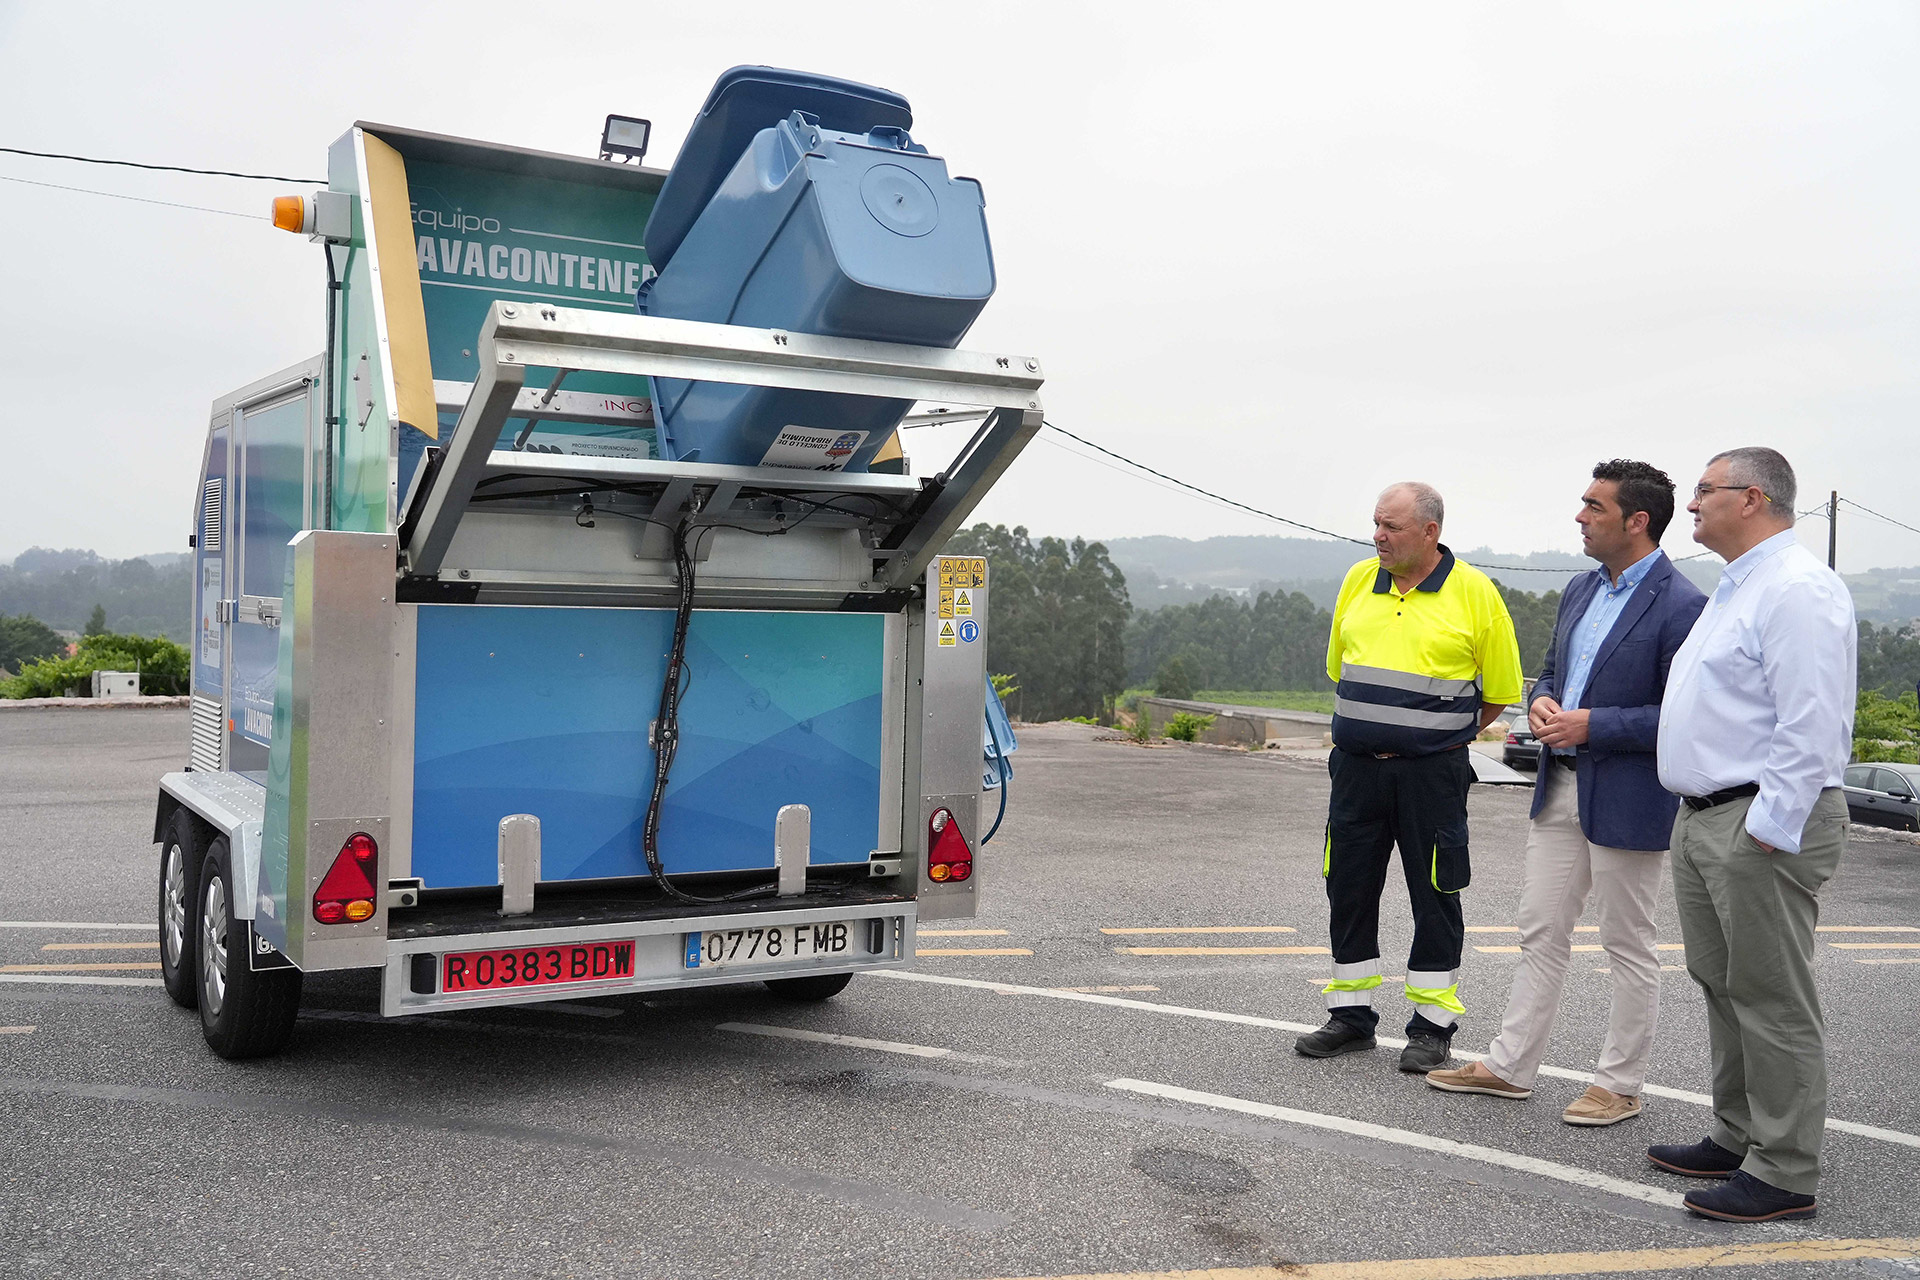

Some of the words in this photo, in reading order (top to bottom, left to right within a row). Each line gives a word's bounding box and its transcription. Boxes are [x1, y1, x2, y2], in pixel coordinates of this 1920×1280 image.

[417, 235, 658, 295] AVACONTENE
[777, 438, 787, 446] DE
[781, 433, 833, 444] RIBADUMIA
[789, 440, 829, 449] CONCELLO
[689, 953, 697, 962] E
[707, 927, 783, 962] 0778
[794, 923, 848, 955] FMB
[476, 950, 562, 985] 0383
[570, 944, 631, 978] BDW
